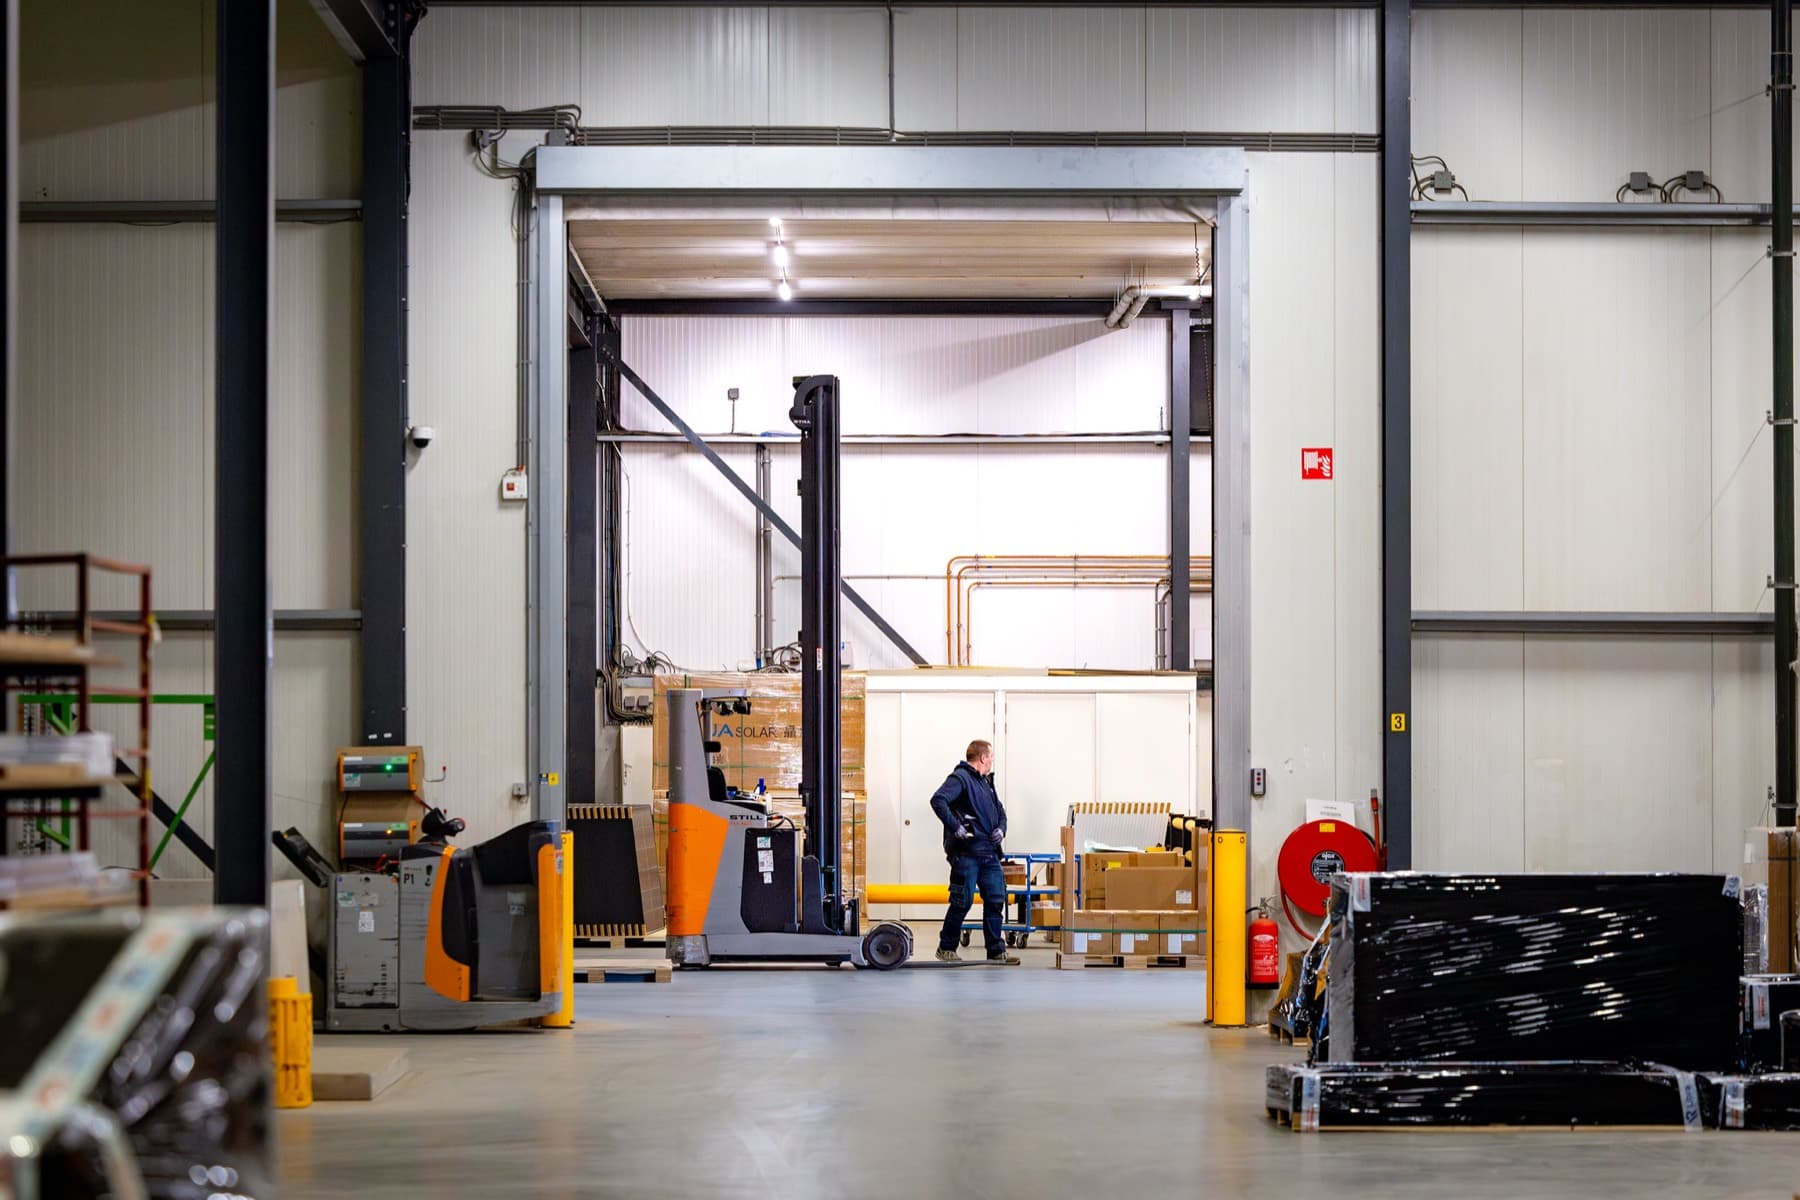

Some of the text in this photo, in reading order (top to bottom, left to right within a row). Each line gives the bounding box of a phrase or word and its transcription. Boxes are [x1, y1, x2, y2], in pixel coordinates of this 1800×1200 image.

[1394, 716, 1402, 729] 3
[712, 723, 777, 738] JA SOLAR
[403, 873, 414, 885] P1
